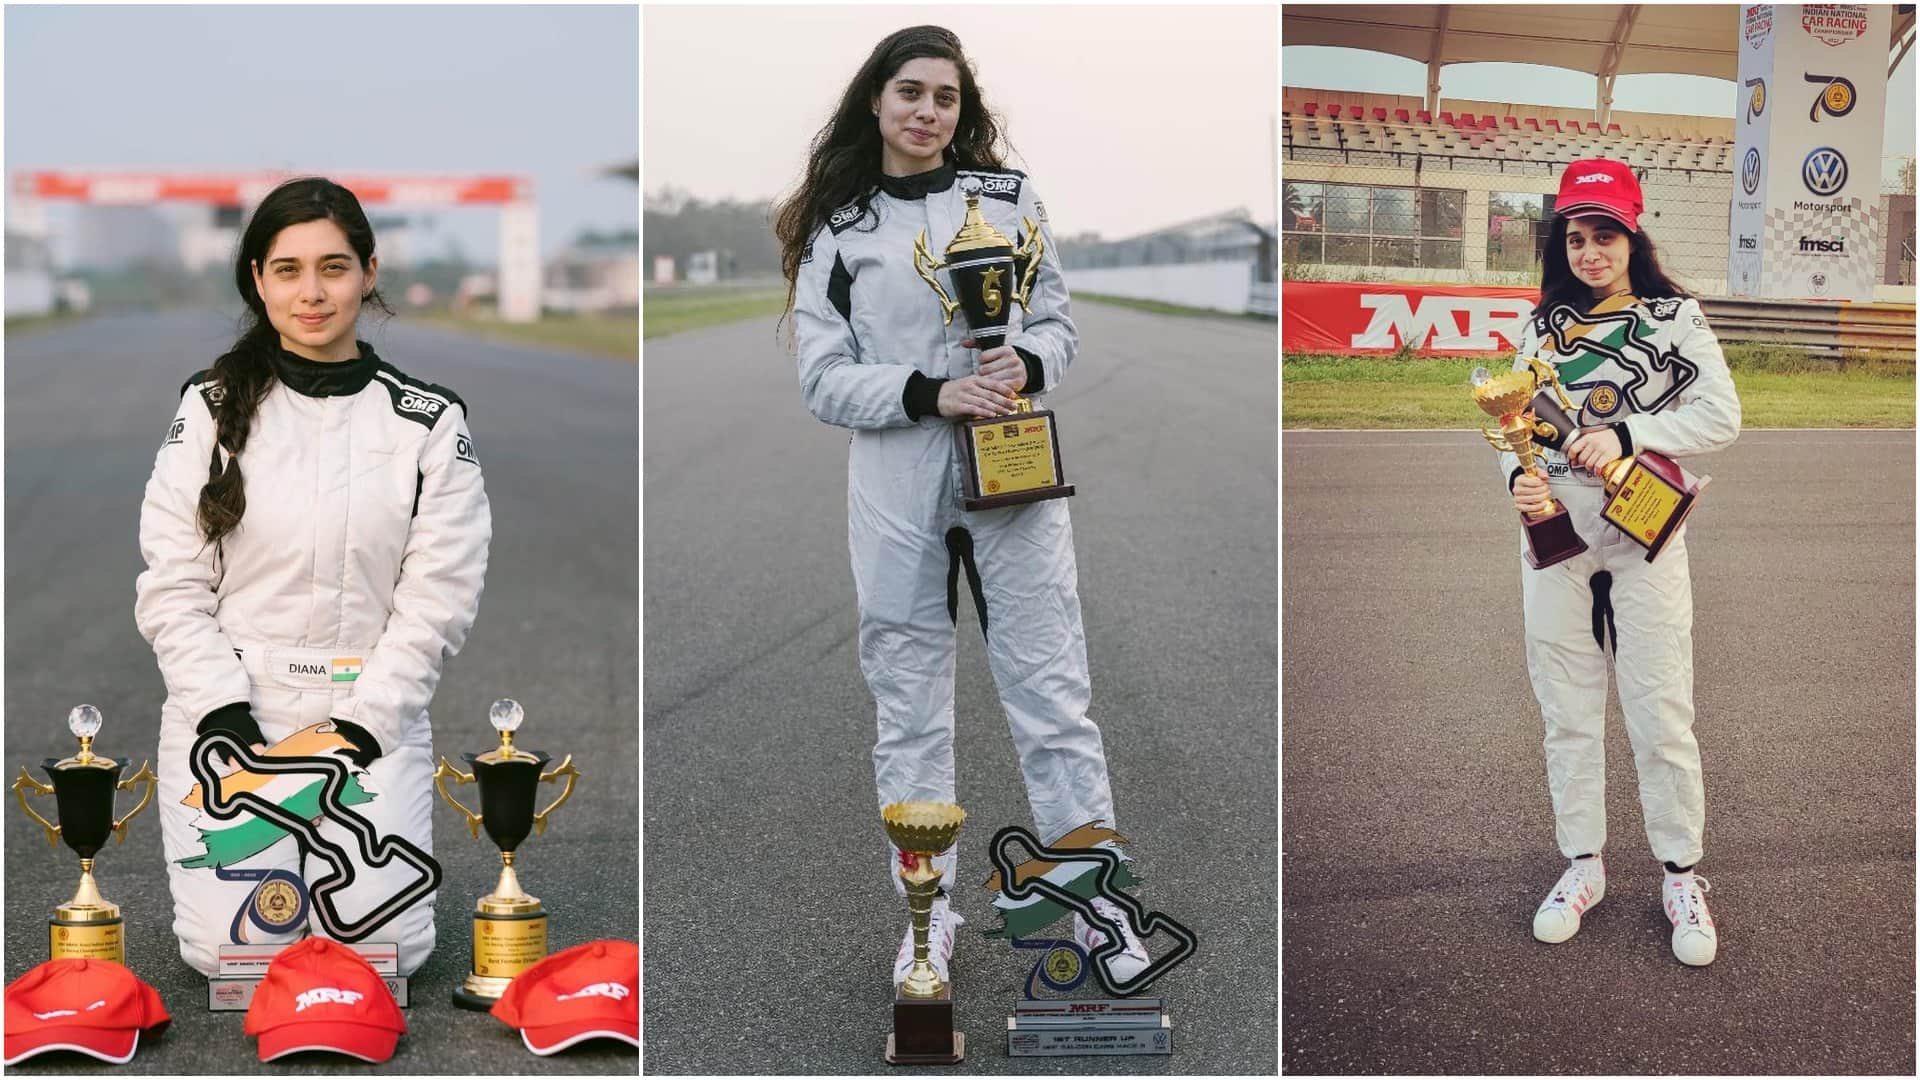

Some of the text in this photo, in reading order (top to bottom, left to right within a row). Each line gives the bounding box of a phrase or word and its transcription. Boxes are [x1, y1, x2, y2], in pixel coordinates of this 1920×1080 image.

[1802, 8, 1868, 19] INDIAN NATIONAL
[1802, 15, 1867, 30] CAR RACING
[1575, 172, 1615, 184] MRF
[983, 179, 1018, 191] OMP
[1793, 200, 1852, 213] Motorsport
[1798, 236, 1844, 252] fmsci
[1351, 293, 1538, 350] MR
[400, 395, 440, 413] OMP
[1547, 464, 1569, 476] OMP
[289, 663, 327, 675] DIANA
[295, 987, 364, 1012] MRF
[1069, 1004, 1111, 1013] MRF
[1073, 1035, 1118, 1043] RUNNER
[1120, 1034, 1136, 1042] UP
